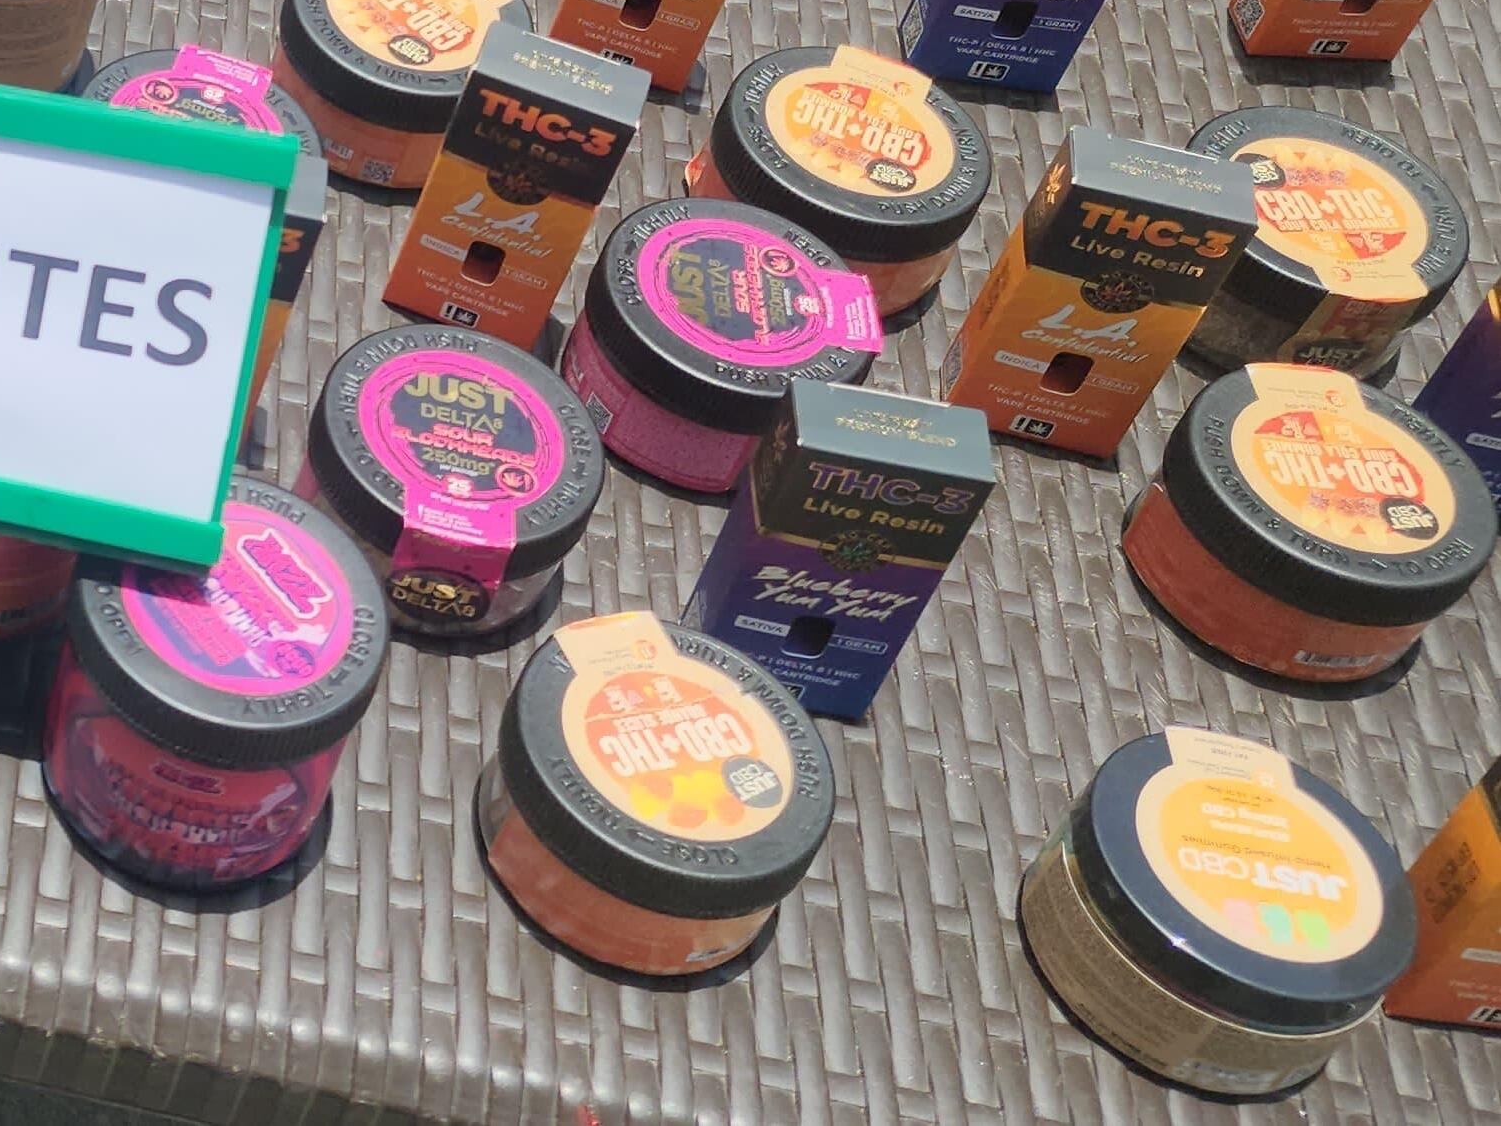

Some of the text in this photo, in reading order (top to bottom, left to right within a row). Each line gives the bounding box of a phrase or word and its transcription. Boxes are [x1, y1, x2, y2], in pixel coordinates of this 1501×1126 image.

[959, 7, 1077, 30] SATIVA GRAM
[314, 14, 422, 85] DOWN TURN
[982, 49, 1040, 64] CARTRIDGE
[480, 88, 617, 157] THC-3
[792, 97, 926, 168] CBD+THC
[1255, 188, 1395, 221] CBD+THC
[440, 214, 552, 259] Confidential
[784, 229, 834, 267] OPEN
[1080, 201, 1238, 259] THC-3
[1070, 234, 1206, 279] Live Resin
[669, 249, 711, 323] JUST
[1021, 328, 1149, 363] Confidential
[1037, 304, 1138, 348] L.A.
[999, 352, 1043, 371] INDICA
[403, 372, 515, 416] JUST
[432, 424, 494, 447] SOUR
[421, 448, 497, 476] 250mg
[1262, 447, 1423, 498] CBD+THC
[809, 461, 975, 515] THC-3
[801, 496, 945, 536] Live Resin
[391, 575, 480, 604] JUST
[753, 565, 918, 608] Blueberry
[753, 582, 896, 623] Yum Yum
[845, 639, 883, 652] GRAM
[673, 632, 823, 800] TURN DOWN PUSH
[600, 711, 754, 777] CBD+THC
